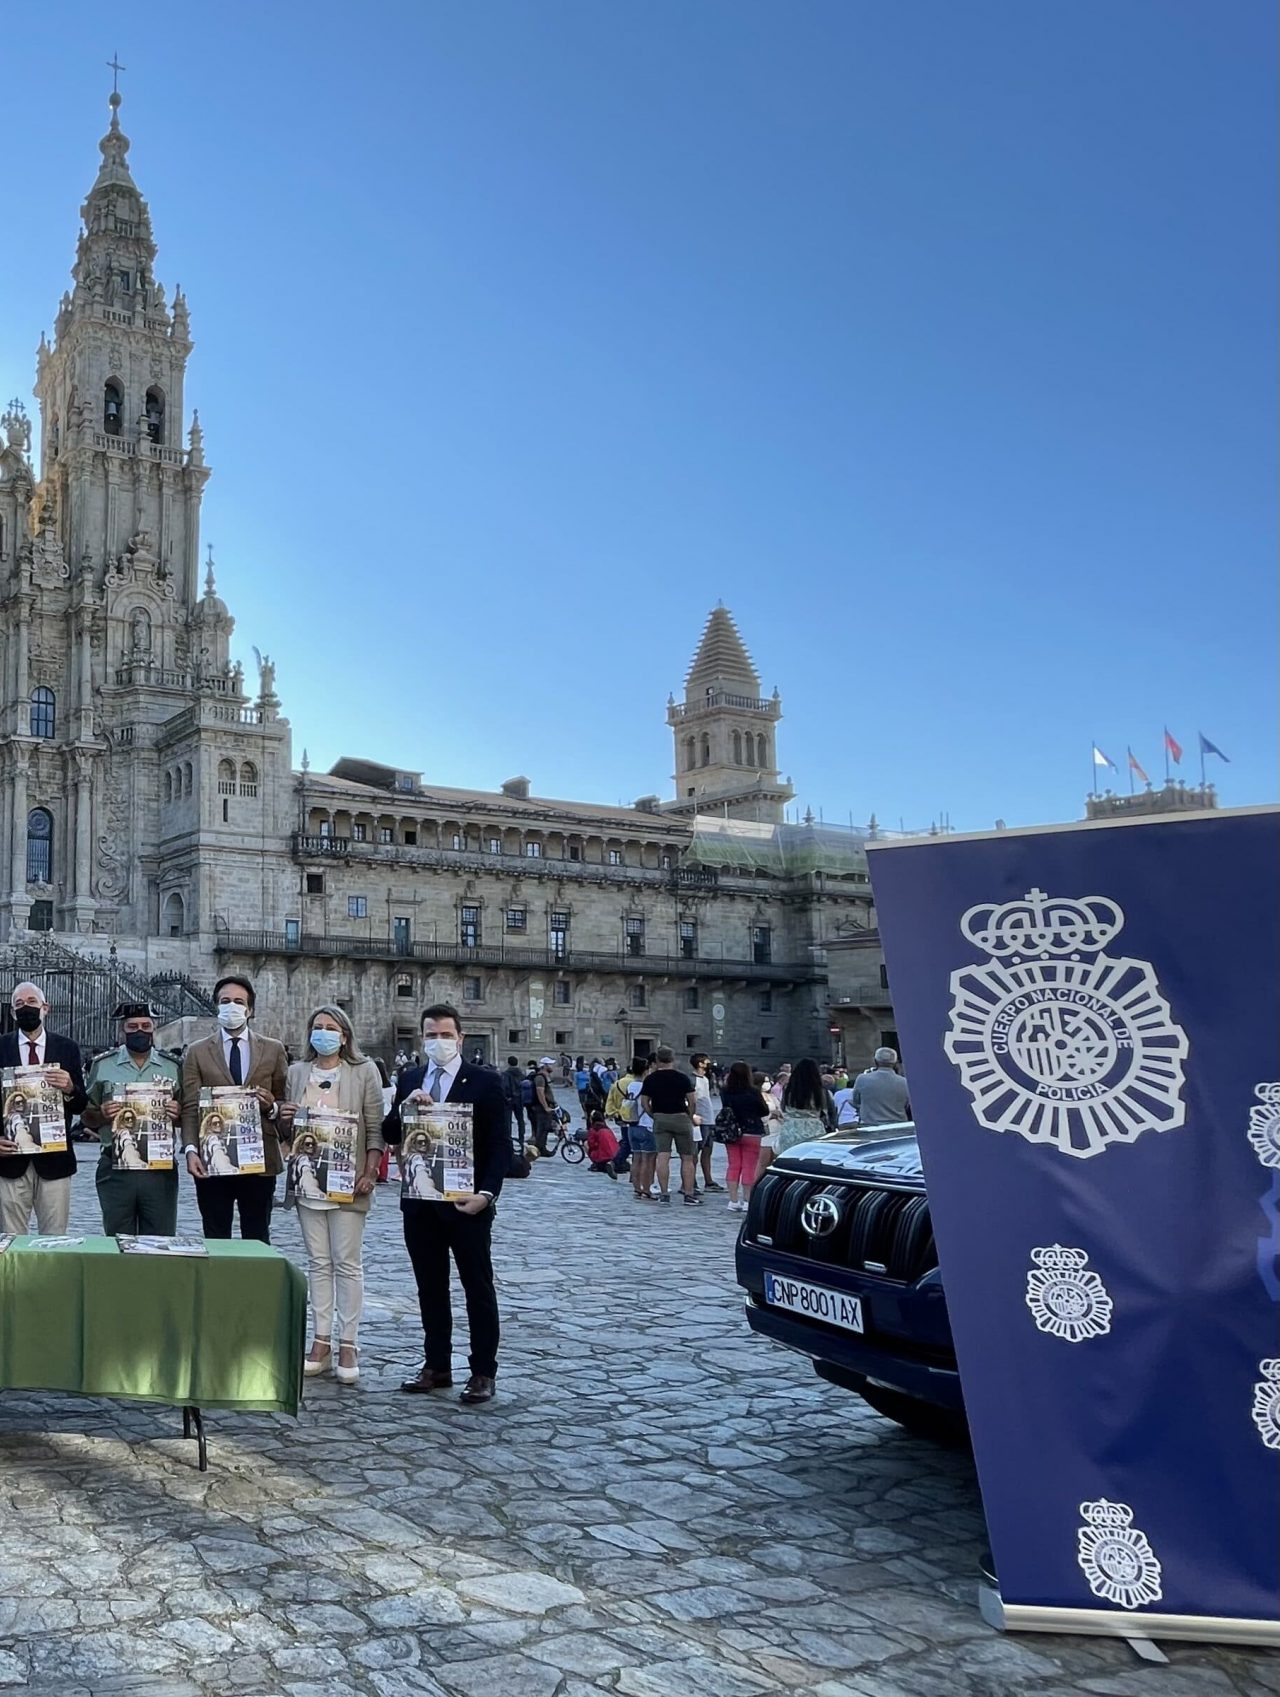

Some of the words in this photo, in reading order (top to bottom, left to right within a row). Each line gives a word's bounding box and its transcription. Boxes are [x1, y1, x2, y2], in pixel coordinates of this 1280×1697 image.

[992, 996, 1030, 1054] CUERPO
[1030, 988, 1119, 1027] NACIONAL
[1113, 1027, 1134, 1049] DE
[1035, 1081, 1111, 1101] POLICIA
[42, 1104, 59, 1112] 091
[45, 1114, 60, 1122] 112
[151, 1112, 168, 1121] 062
[151, 1122, 167, 1131] 091
[240, 1125, 257, 1134] 091
[334, 1125, 353, 1137] 016
[152, 1132, 167, 1140] 112
[241, 1135, 257, 1144] 112
[333, 1140, 352, 1151] 062
[448, 1136, 468, 1147] 062
[332, 1151, 351, 1161] 091
[448, 1148, 467, 1158] 091
[333, 1163, 351, 1172] 112
[449, 1160, 468, 1170] 112
[773, 1278, 799, 1307] CNP
[800, 1286, 837, 1321] 8001
[840, 1297, 860, 1328] AX
